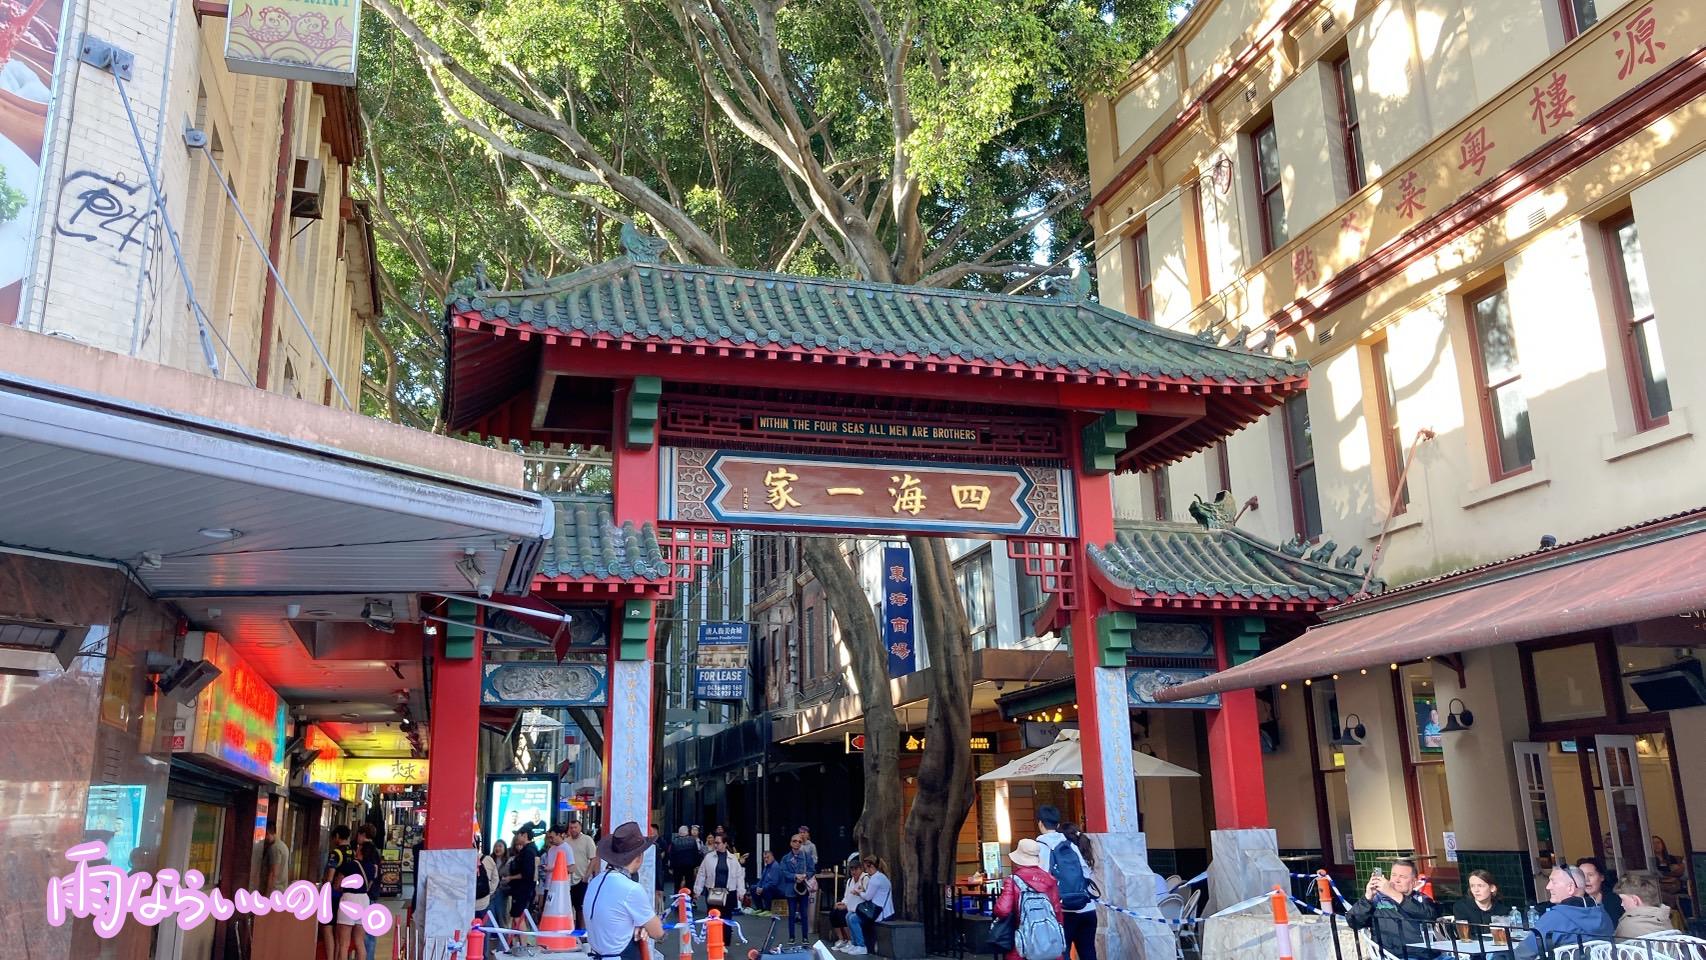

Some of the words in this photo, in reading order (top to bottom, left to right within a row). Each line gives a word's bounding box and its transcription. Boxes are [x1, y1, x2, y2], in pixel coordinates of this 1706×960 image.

[759, 416, 789, 430] WITHIN
[793, 418, 810, 431] THE
[814, 420, 838, 433] FOUR
[842, 422, 865, 434] SEAS
[869, 423, 886, 435] ALL
[889, 425, 908, 437] MEN
[912, 426, 929, 438] ARE
[932, 427, 977, 440] BROTHERS
[889, 565, 911, 660] 東海商場
[699, 671, 715, 681] FOR
[717, 670, 742, 681] LEASE
